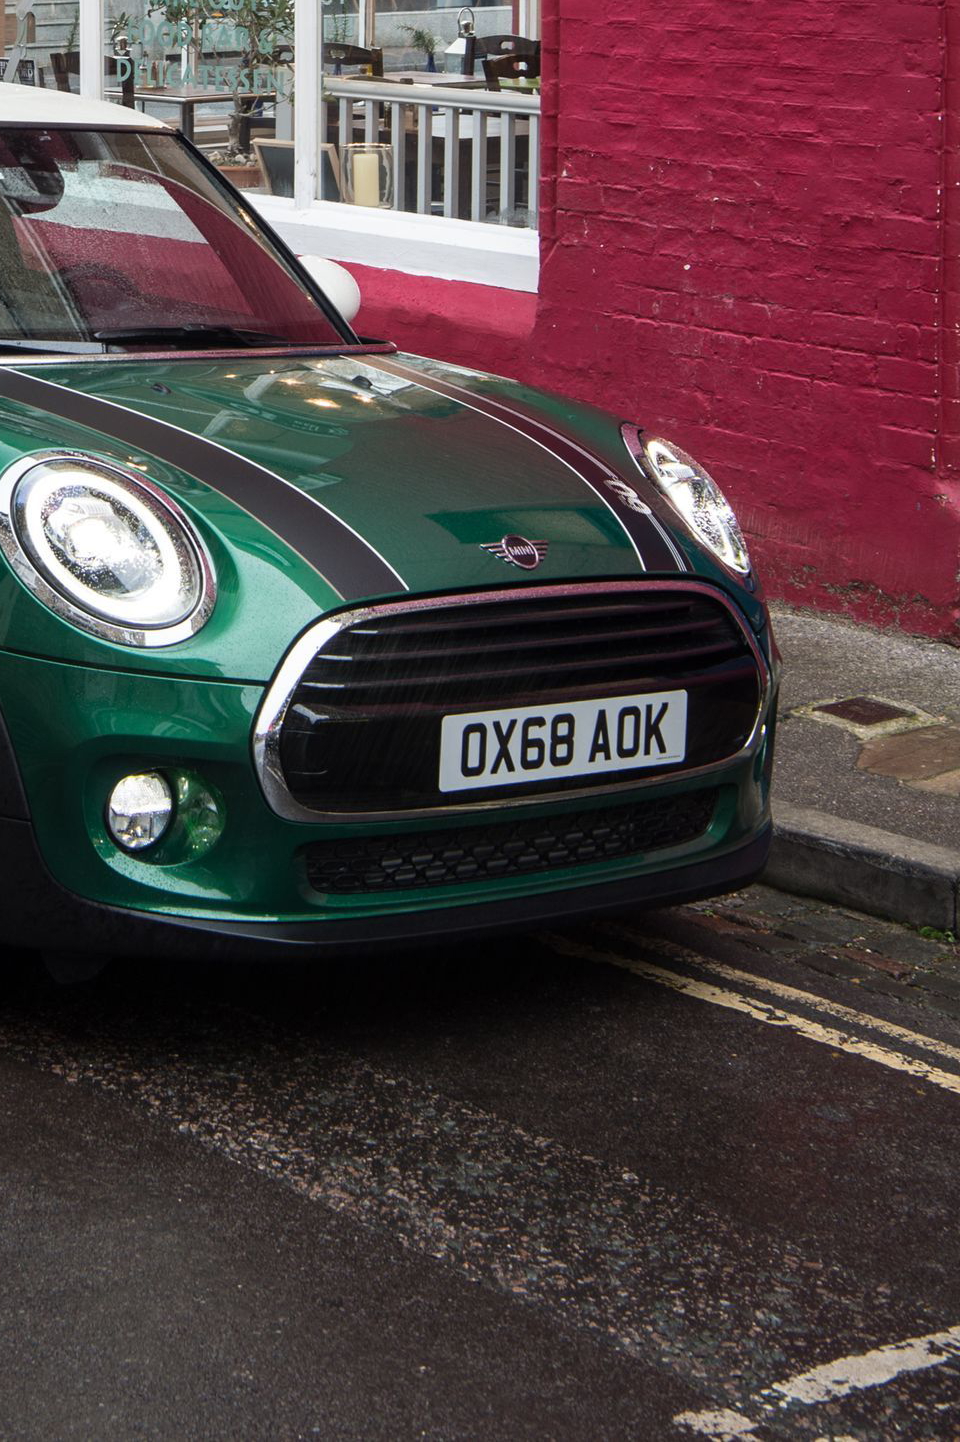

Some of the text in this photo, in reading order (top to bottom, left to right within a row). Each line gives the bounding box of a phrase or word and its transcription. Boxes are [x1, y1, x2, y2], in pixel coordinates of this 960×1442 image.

[127, 18, 274, 55] FOOD BAR &
[116, 58, 285, 95] DELICATESSEN
[507, 545, 534, 556] MINI
[460, 701, 669, 778] OX68 AOK
